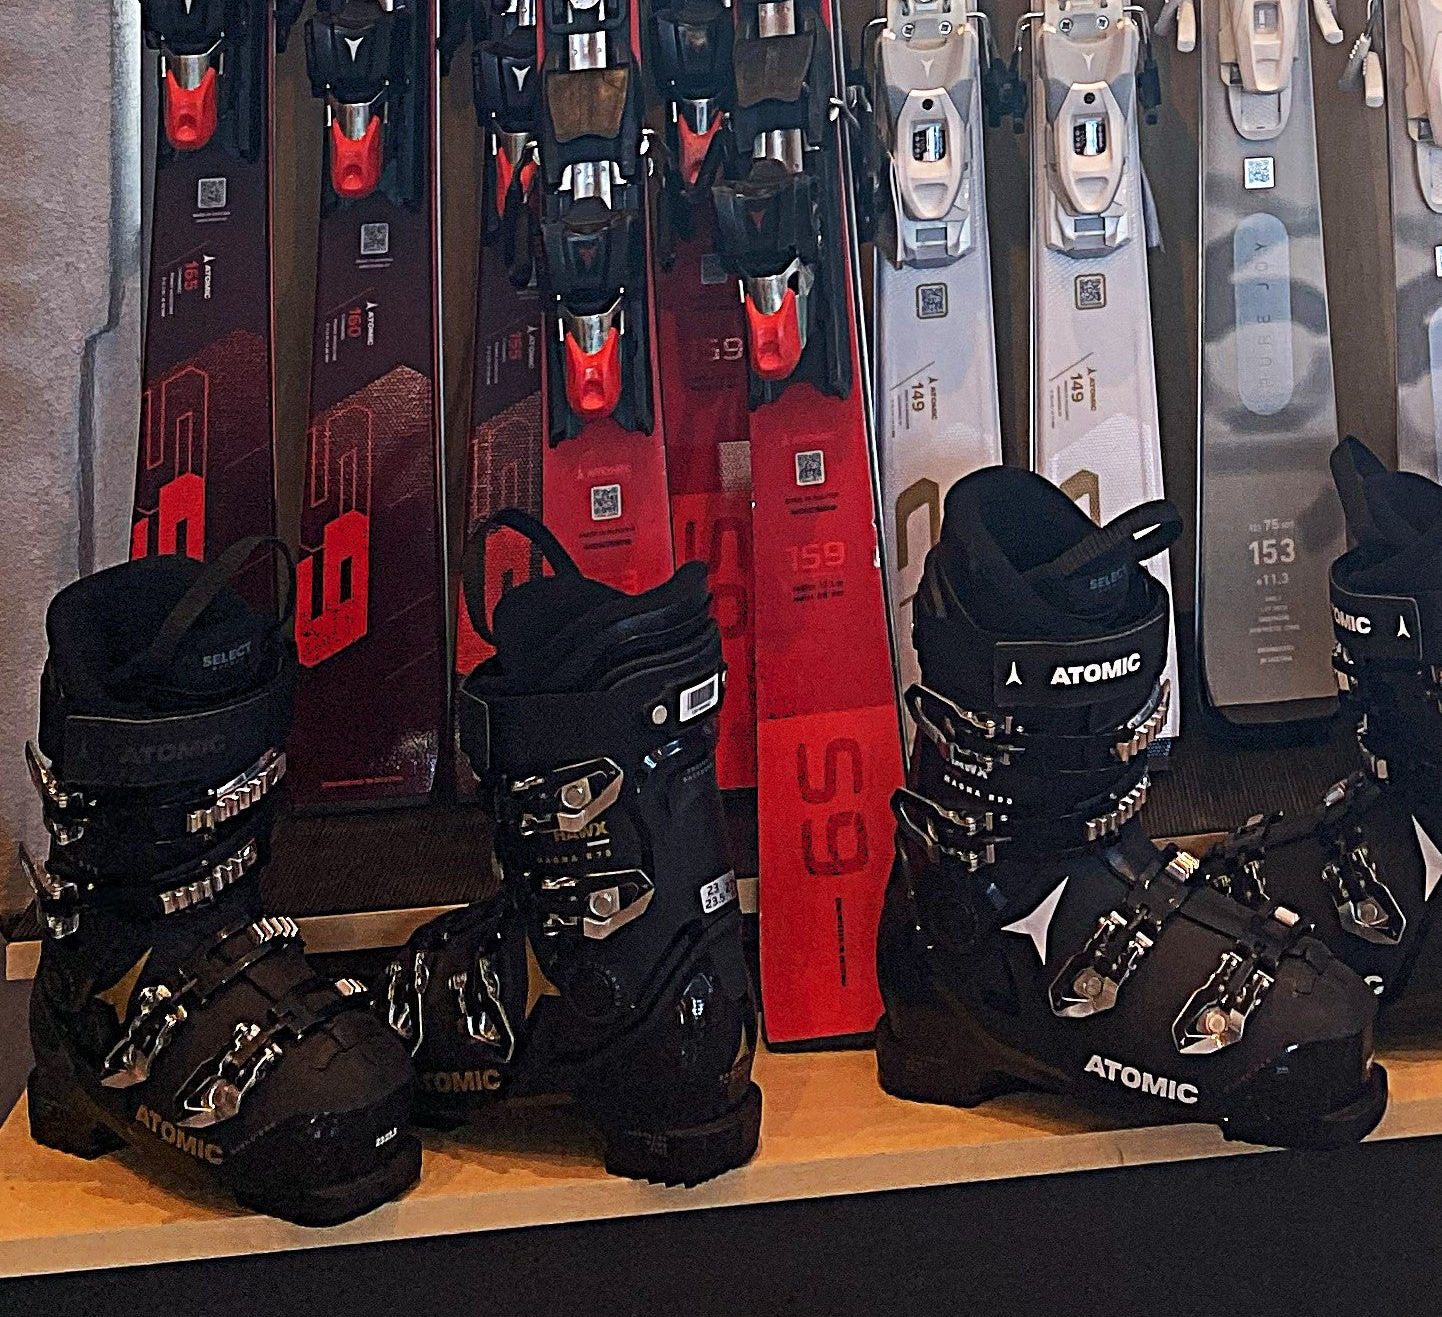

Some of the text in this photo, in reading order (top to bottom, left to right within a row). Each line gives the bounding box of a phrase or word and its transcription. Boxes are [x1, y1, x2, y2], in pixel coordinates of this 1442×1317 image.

[1255, 241, 1271, 291] JOY
[911, 382, 925, 413] 149
[1070, 372, 1085, 404] 149
[1263, 518, 1280, 531] 75
[786, 540, 846, 572] 159
[1249, 538, 1296, 565] 153
[1089, 565, 1127, 591] SELEC
[1333, 605, 1372, 635] OMIC
[203, 641, 254, 669] SELECT
[1050, 652, 1142, 686] ATOMIC
[799, 737, 871, 877] S9
[704, 891, 727, 910] 23.5
[706, 882, 721, 897] 23
[1083, 1053, 1201, 1106] ATOMIC
[135, 1104, 224, 1166] ATOMIC
